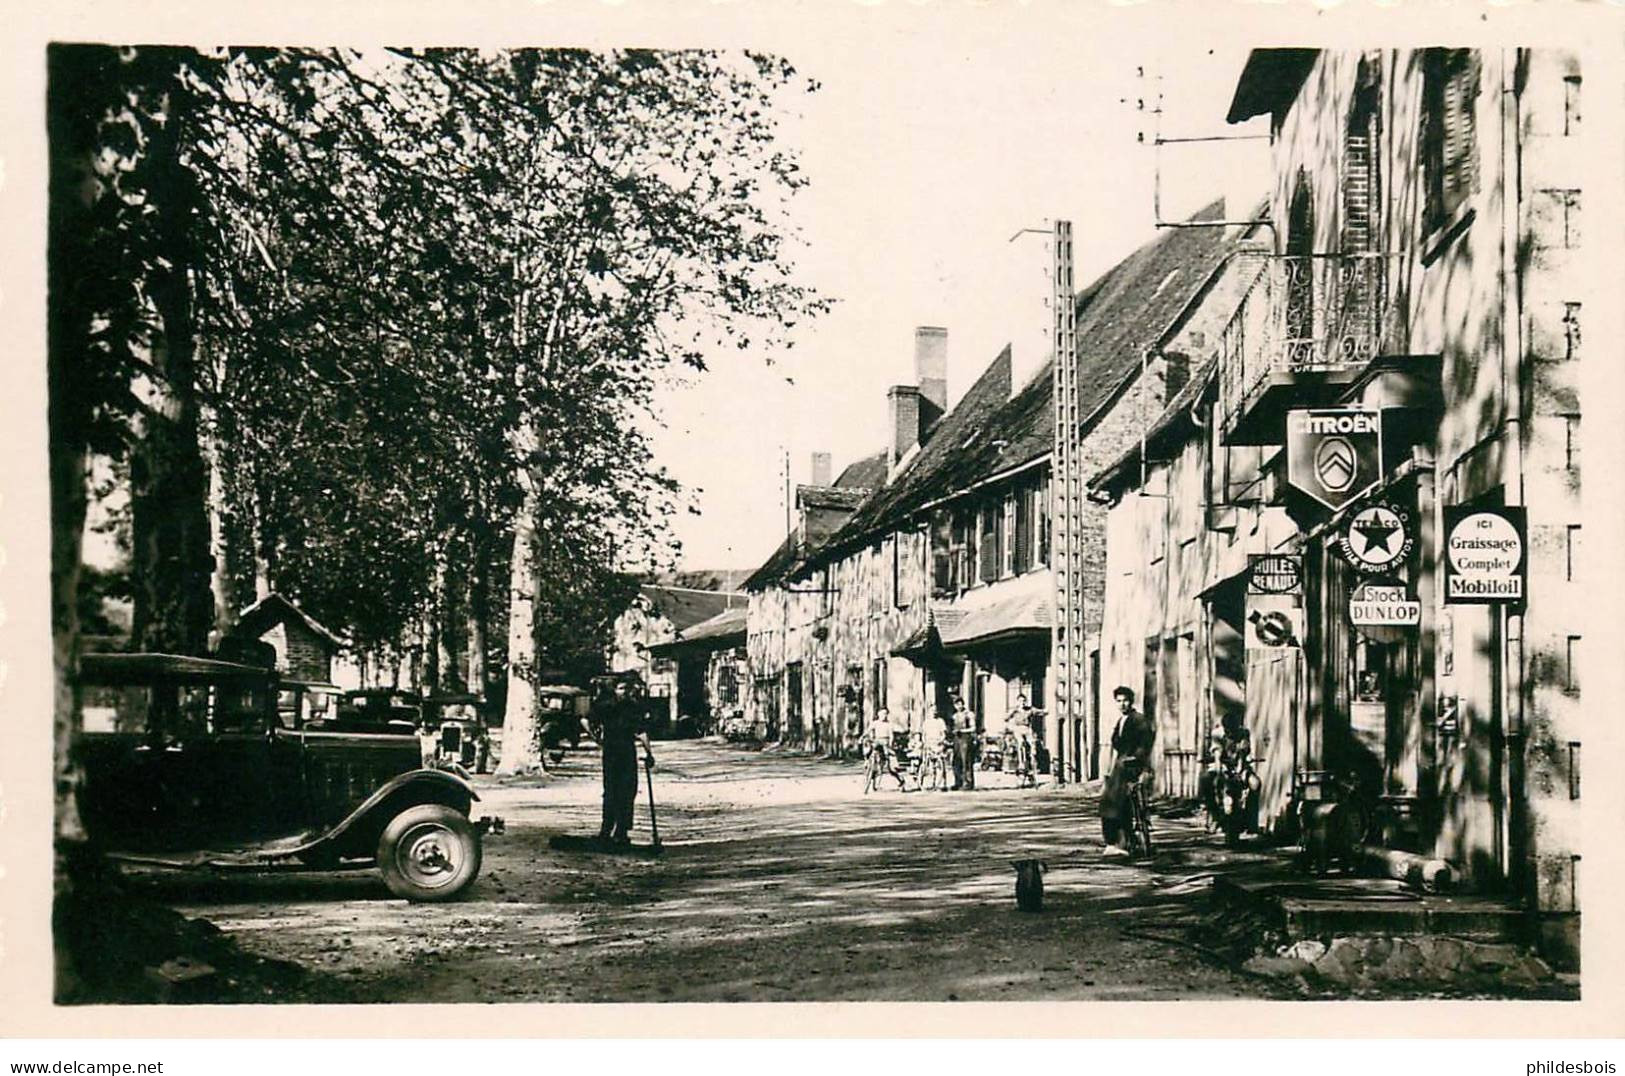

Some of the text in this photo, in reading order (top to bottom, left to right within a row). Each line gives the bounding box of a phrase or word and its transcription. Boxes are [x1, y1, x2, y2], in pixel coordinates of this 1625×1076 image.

[1477, 520, 1492, 528] ICI
[1450, 537, 1517, 553] Graissage
[1340, 537, 1413, 573] HUILE POUR AUTOS
[1255, 558, 1295, 574] HUILES
[1458, 558, 1510, 573] Complet
[1253, 575, 1297, 590] RENAULT
[1452, 579, 1518, 594] Mobiloil
[1367, 588, 1404, 602] Stock
[1354, 606, 1417, 620] DUNLOP
